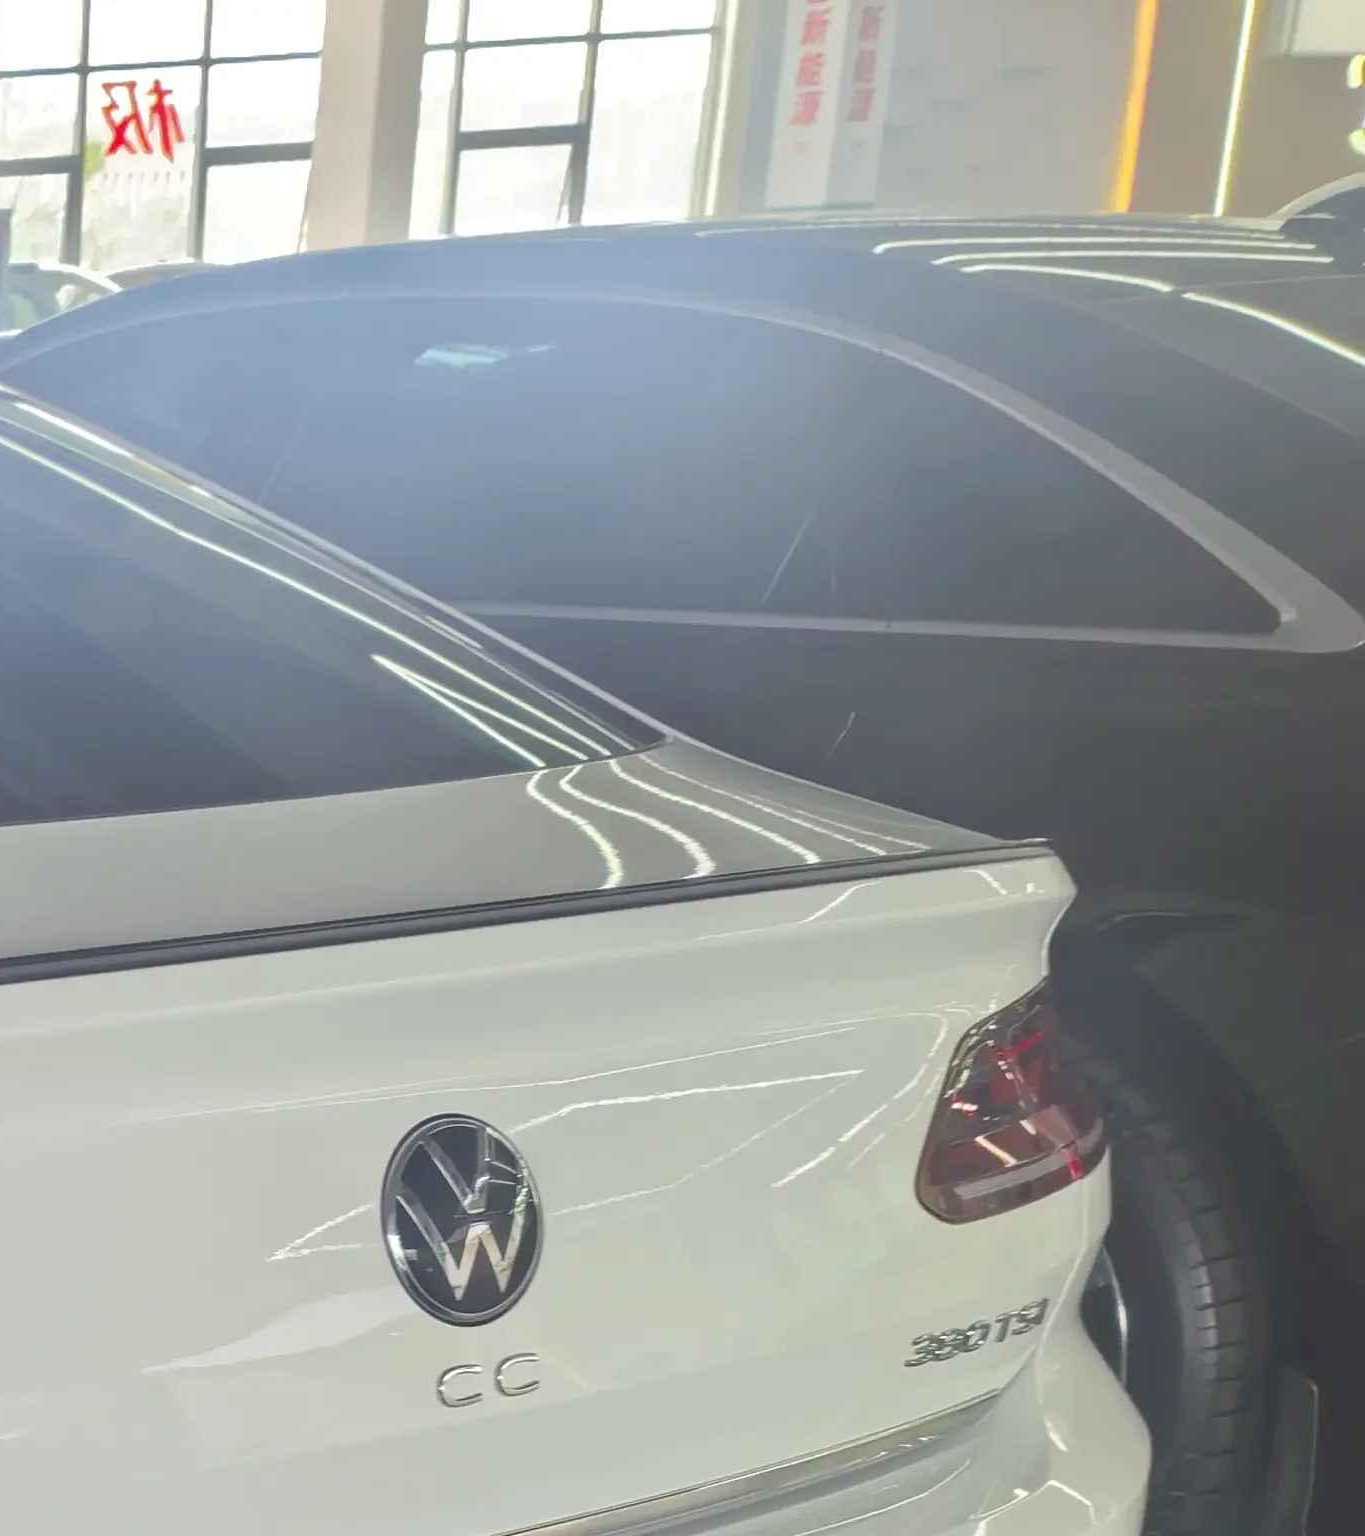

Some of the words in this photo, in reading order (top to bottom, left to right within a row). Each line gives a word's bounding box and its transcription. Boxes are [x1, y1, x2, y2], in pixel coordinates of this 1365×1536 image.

[789, 0, 831, 126] 新能源
[436, 1352, 540, 1408] CC
